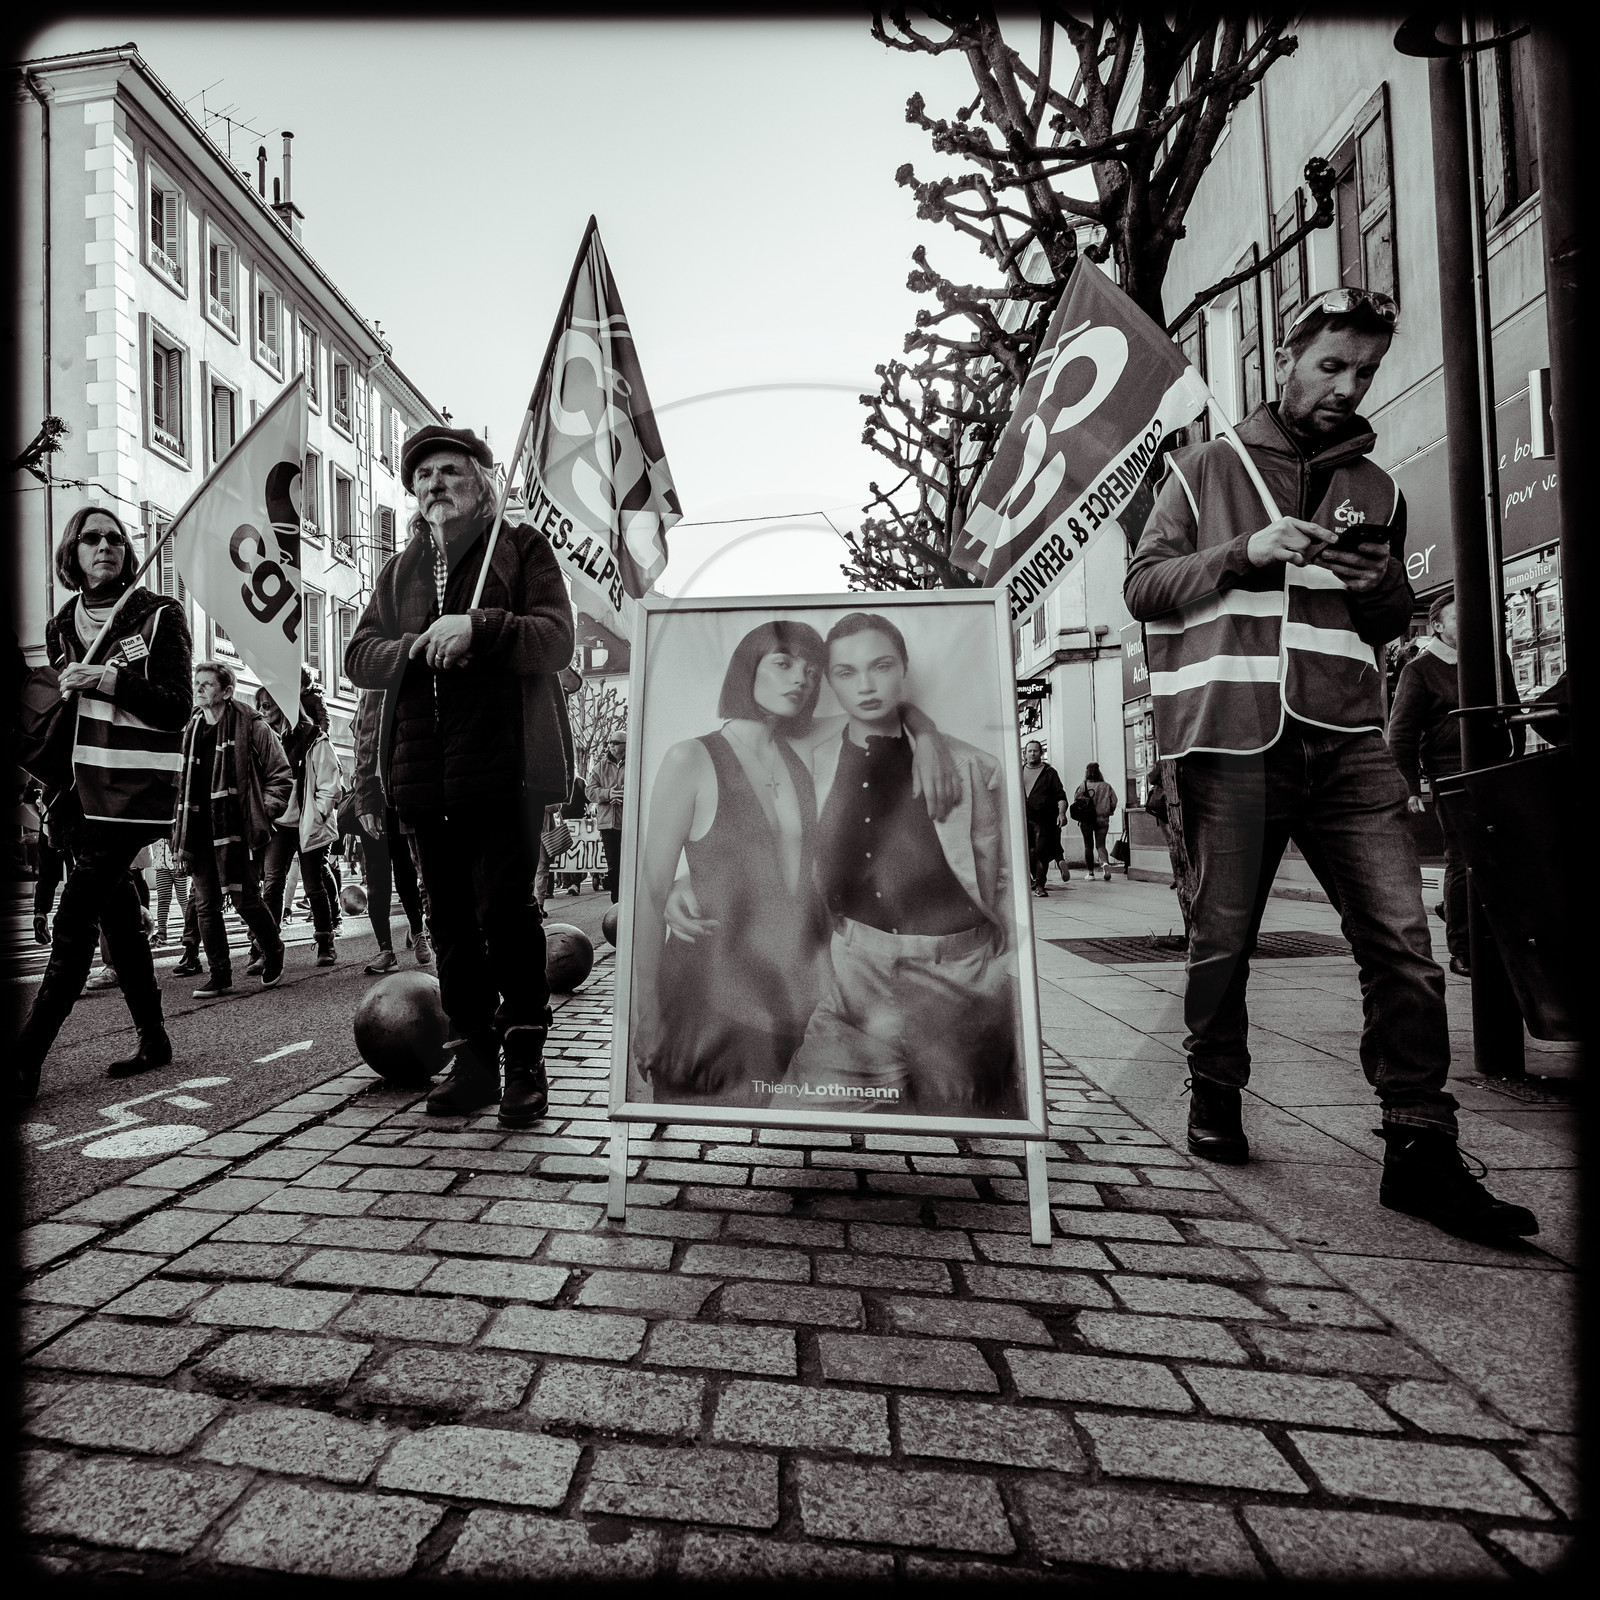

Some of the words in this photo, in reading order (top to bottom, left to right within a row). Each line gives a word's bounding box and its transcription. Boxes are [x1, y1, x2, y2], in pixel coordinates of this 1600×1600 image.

[1504, 480, 1537, 519] pour
[1406, 544, 1436, 580] er
[1505, 563, 1552, 587] Immobilier
[549, 839, 609, 870] MIE
